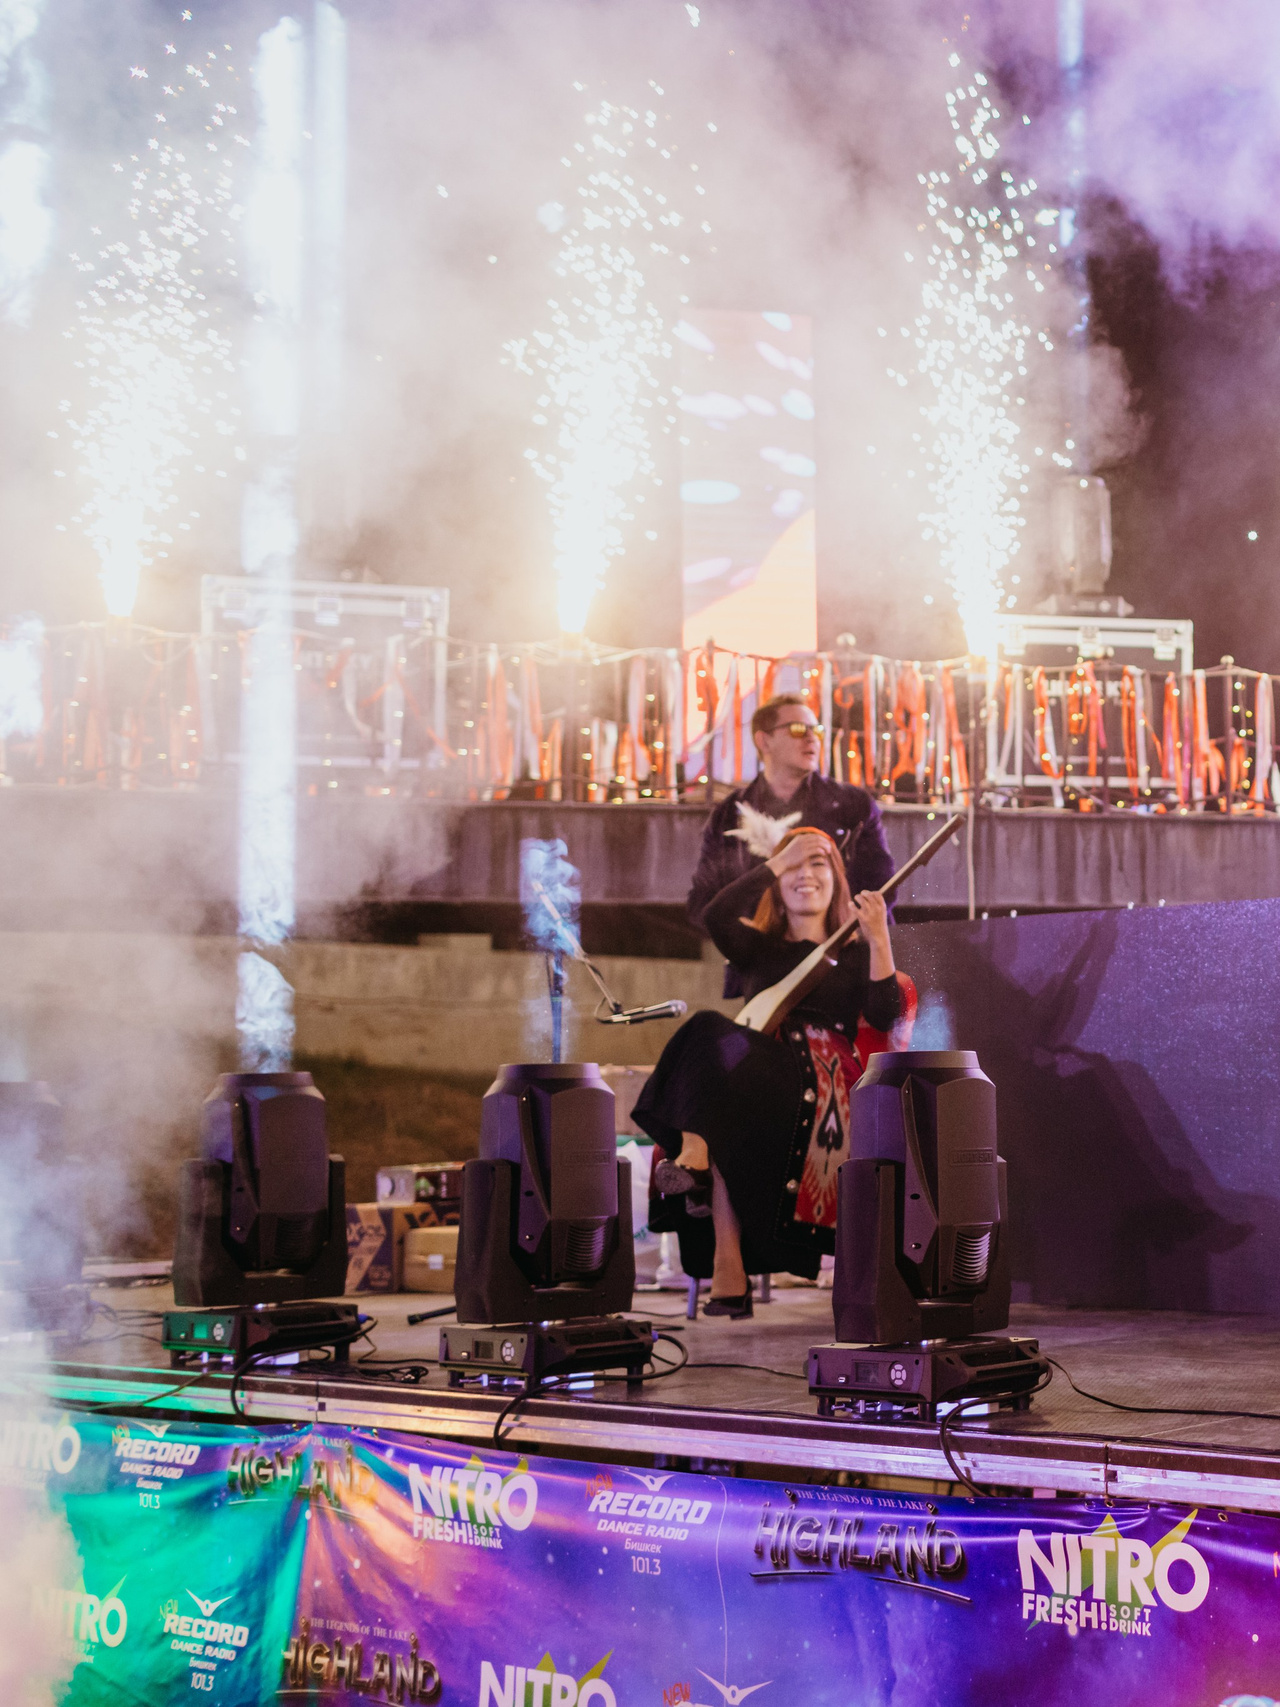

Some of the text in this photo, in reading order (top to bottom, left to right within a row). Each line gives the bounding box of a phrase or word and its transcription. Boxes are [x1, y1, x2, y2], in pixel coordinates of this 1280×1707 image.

[115, 1438, 201, 1466] RECORD
[120, 1462, 184, 1480] DANCE RADIO
[408, 1462, 538, 1531] NITRO
[588, 1490, 712, 1524] RECORD
[796, 1490, 926, 1511] THE LEGENDS OF THE LAKE
[413, 1516, 474, 1545] FRESH!
[473, 1525, 501, 1538] SOFT
[597, 1519, 689, 1541] DANCE RADIO
[754, 1502, 963, 1579] HIGHLAND
[474, 1536, 503, 1549] DRINK
[624, 1538, 662, 1553] Бишкек
[631, 1556, 661, 1575] 101.3
[1017, 1529, 1210, 1612] NITRO
[1022, 1593, 1108, 1630] FRESH!
[1109, 1604, 1152, 1622] SOFT
[163, 1614, 249, 1647] RECORD
[1109, 1618, 1152, 1636] DRINK
[170, 1639, 236, 1661] DANCE RADIO
[190, 1672, 214, 1691] 101.3
[662, 1682, 691, 1706] NEW
